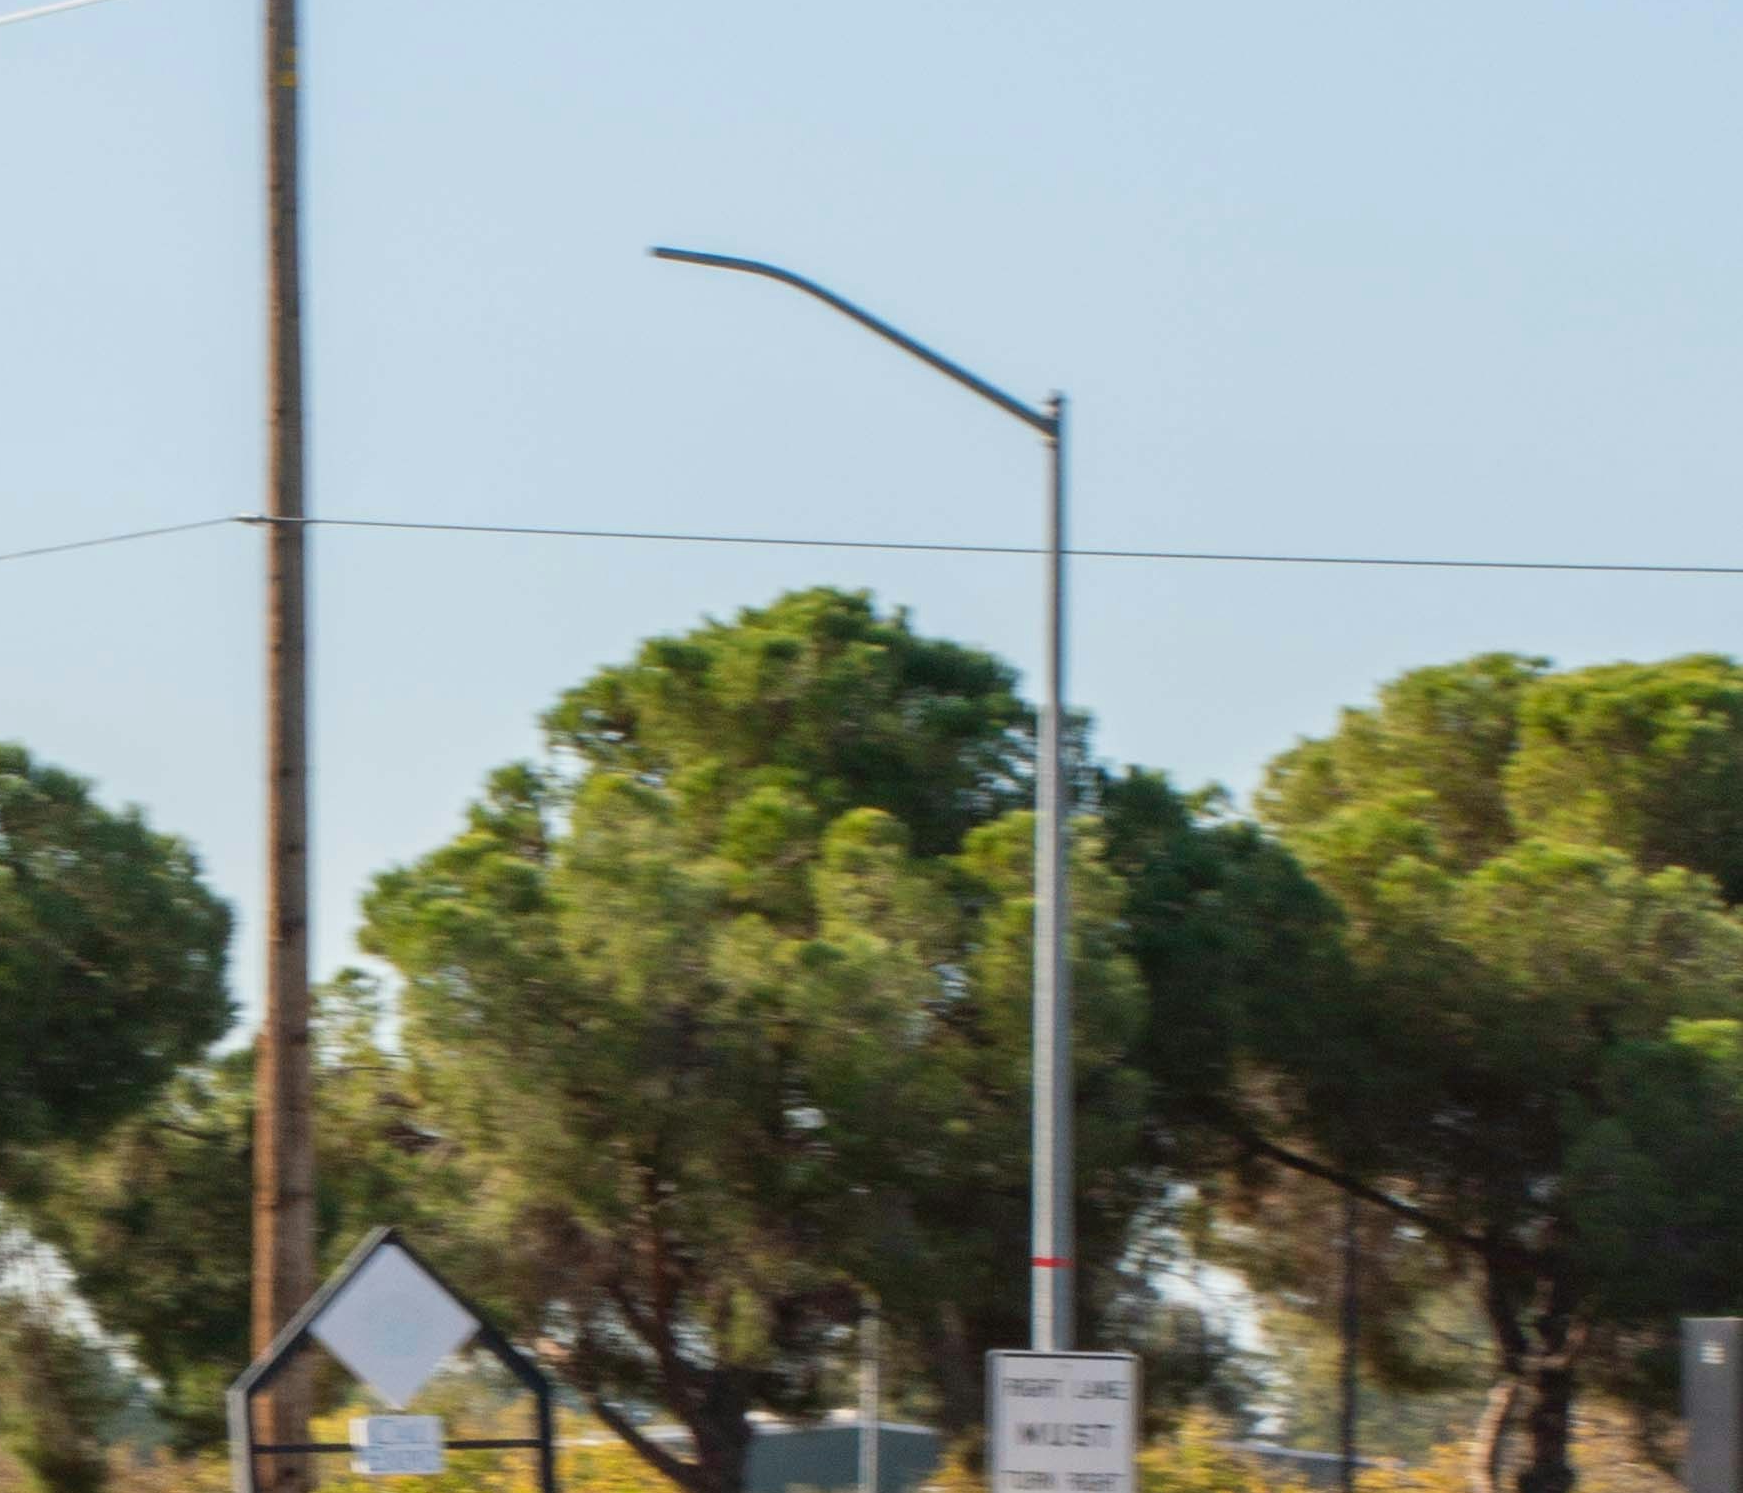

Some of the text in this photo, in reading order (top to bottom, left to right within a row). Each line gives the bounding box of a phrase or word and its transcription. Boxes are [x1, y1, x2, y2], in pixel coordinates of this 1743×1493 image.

[1002, 1378, 1129, 1401] RIGHT LANE
[1015, 1422, 1113, 1448] MUST
[1001, 1469, 1057, 1491] TURN
